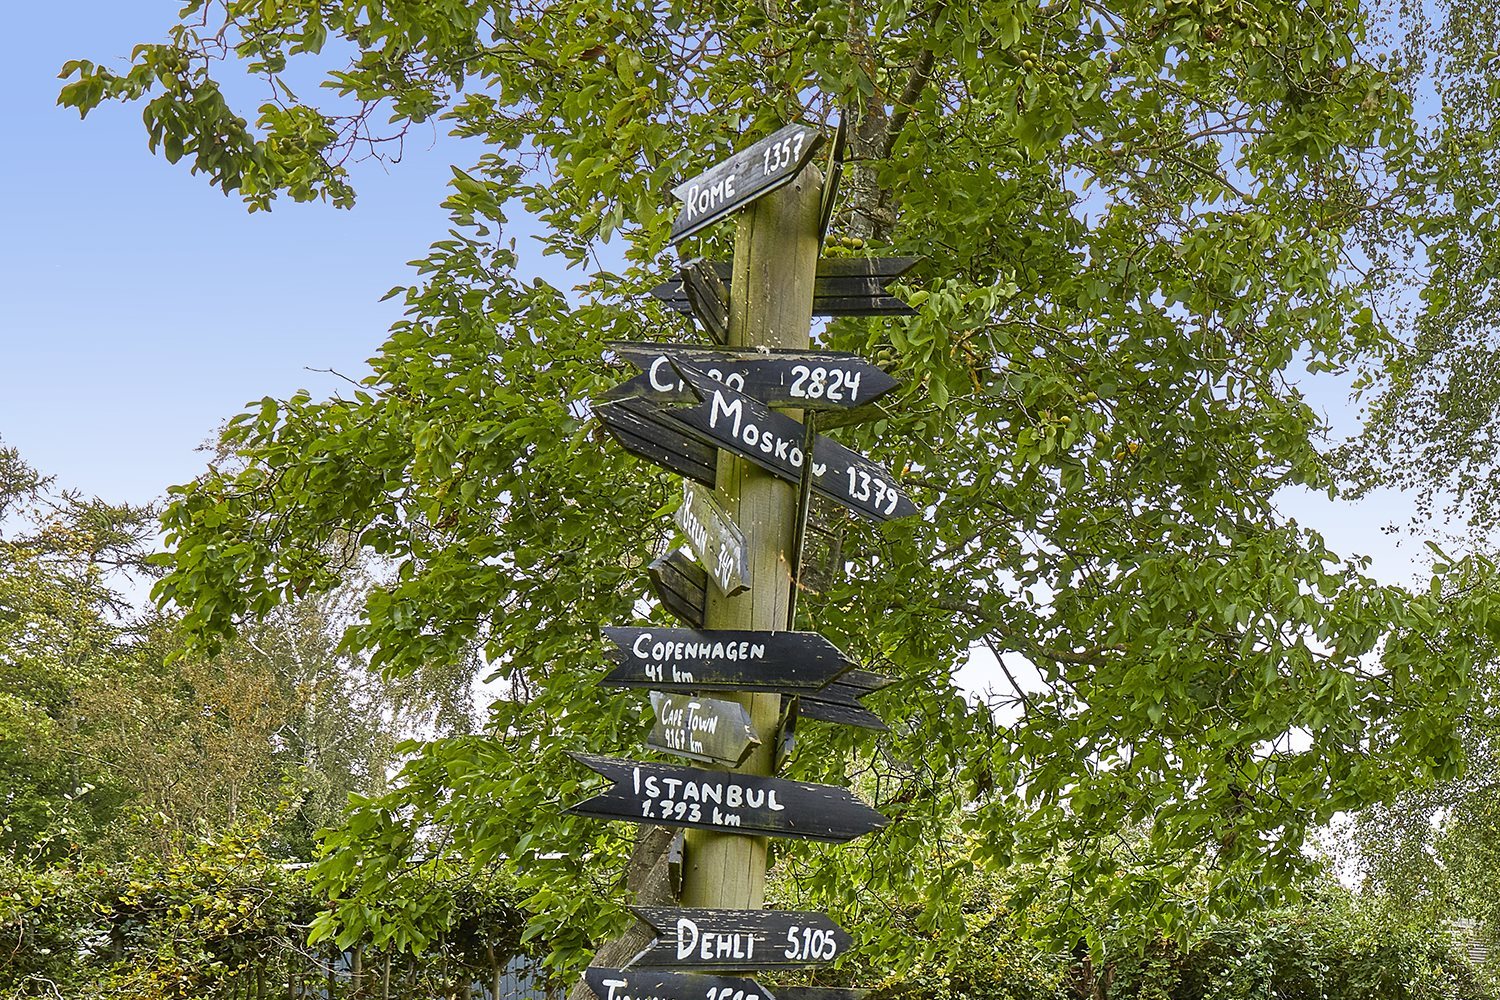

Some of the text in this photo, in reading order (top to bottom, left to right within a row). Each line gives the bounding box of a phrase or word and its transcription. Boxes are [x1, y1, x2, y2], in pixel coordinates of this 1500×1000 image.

[686, 131, 806, 221] ROME 1.357
[790, 365, 861, 401] 2.824
[846, 466, 899, 515] 1.379
[683, 490, 708, 556] BERLIN
[632, 633, 765, 661] COPENHAGEN
[645, 663, 693, 683] 41 km
[661, 699, 719, 735] CAPE TOWN
[690, 732, 704, 754] km
[632, 766, 785, 811] ISTANBUL
[642, 799, 741, 827] 1.793 km
[676, 918, 837, 961] DEHLI 5.105
